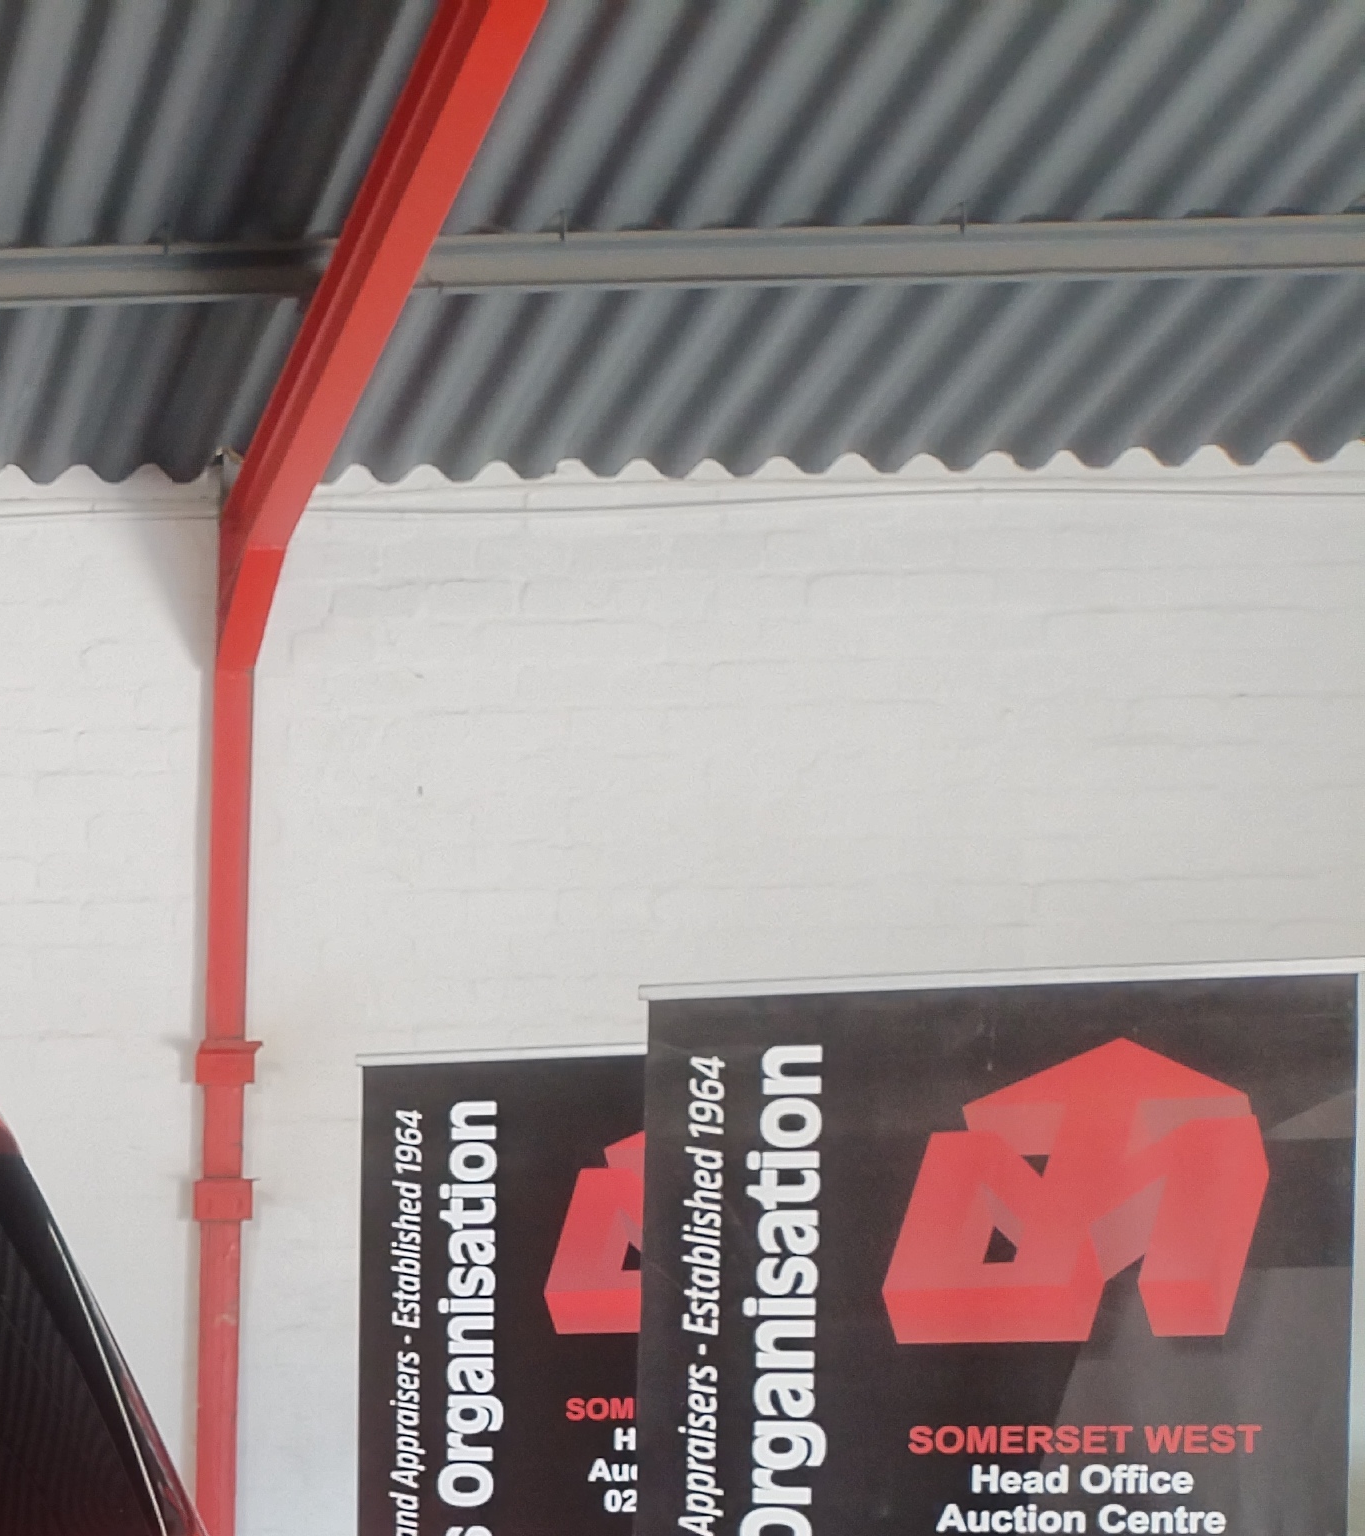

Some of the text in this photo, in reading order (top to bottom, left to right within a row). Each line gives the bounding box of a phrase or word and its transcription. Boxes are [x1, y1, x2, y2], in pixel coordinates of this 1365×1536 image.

[688, 1055, 726, 1138] 1964
[394, 1109, 423, 1174] 1964
[390, 1180, 422, 1329] Established
[681, 1145, 724, 1336] Established
[437, 1100, 504, 1508] Organisation
[389, 1350, 426, 1489] Appraisers
[908, 1424, 1262, 1455] SOMERSET WEST
[935, 1503, 1227, 1535] Auction Centre
[971, 1463, 1195, 1495] Head Office
